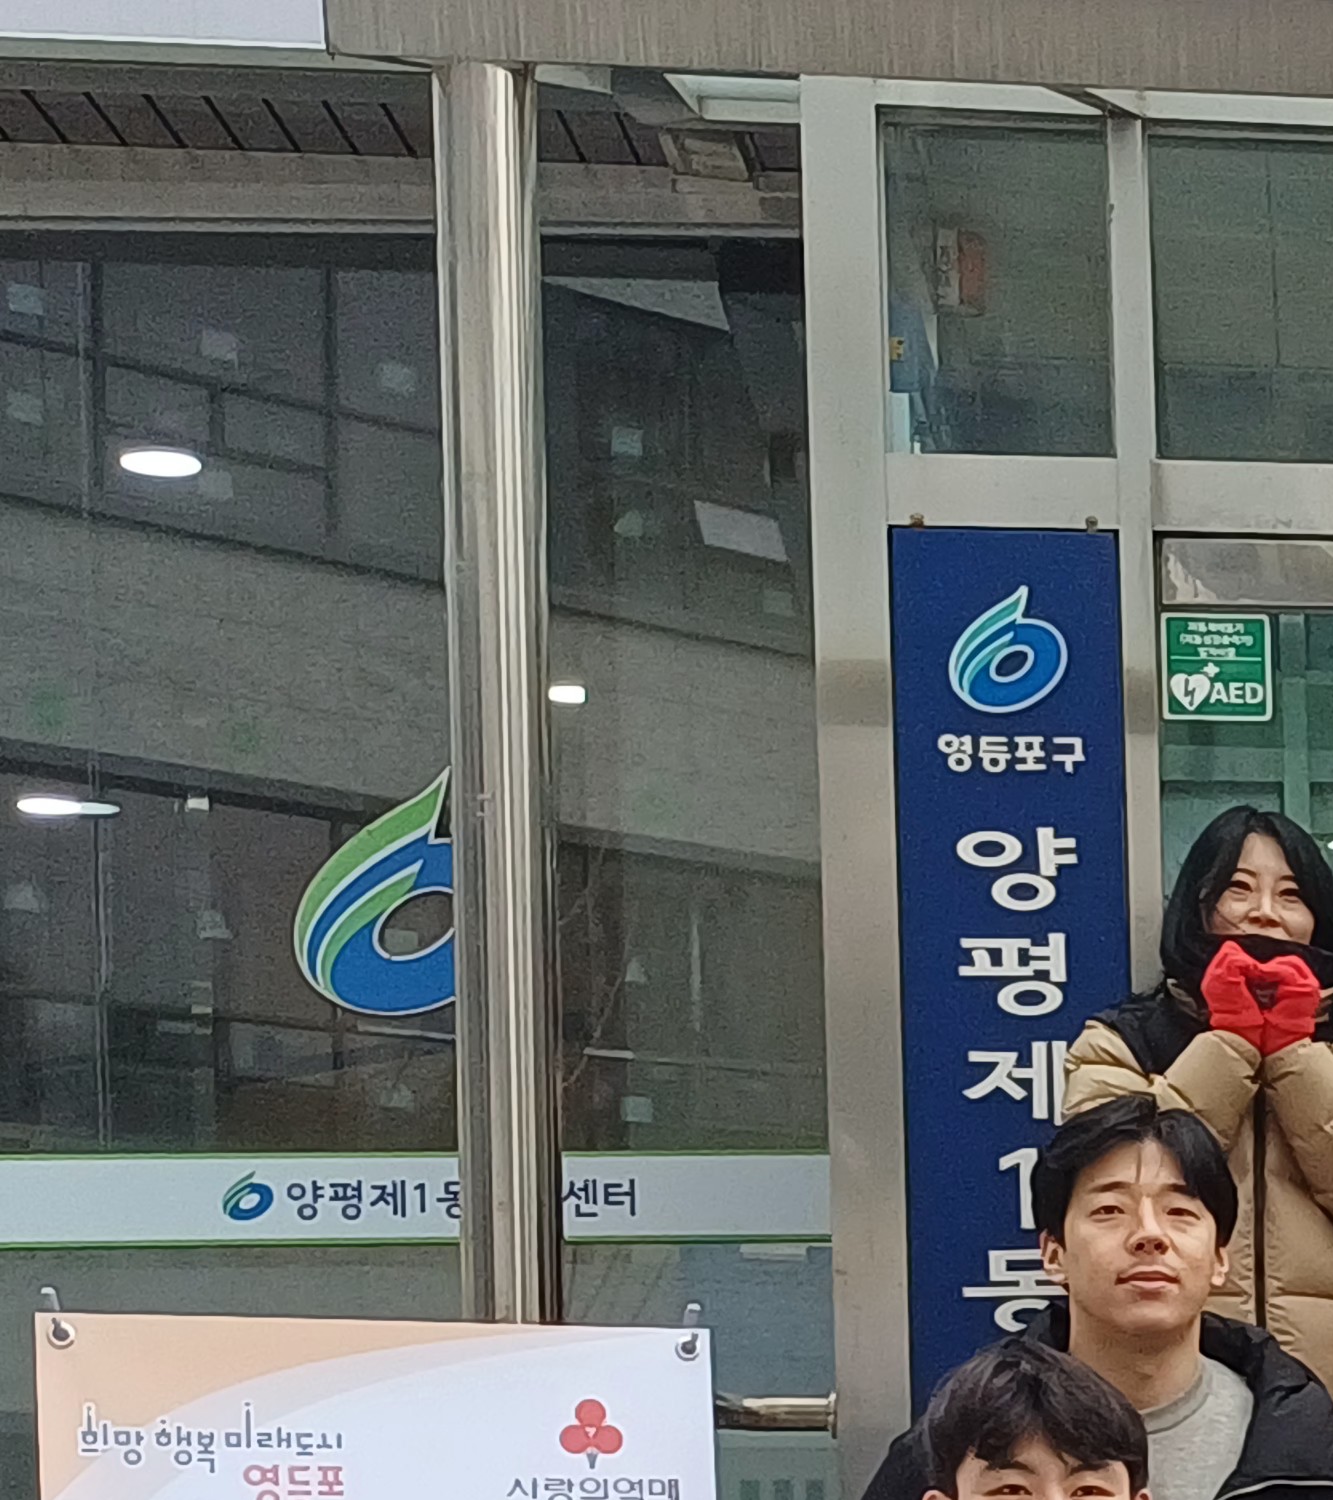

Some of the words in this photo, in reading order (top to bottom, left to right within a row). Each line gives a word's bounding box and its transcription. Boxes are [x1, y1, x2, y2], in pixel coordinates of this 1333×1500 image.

[1209, 682, 1264, 704] AED
[938, 733, 1086, 774] 영등포구
[81, 1406, 144, 1466] 희망
[155, 1419, 216, 1474] 행복
[225, 1401, 343, 1456] 미래도시
